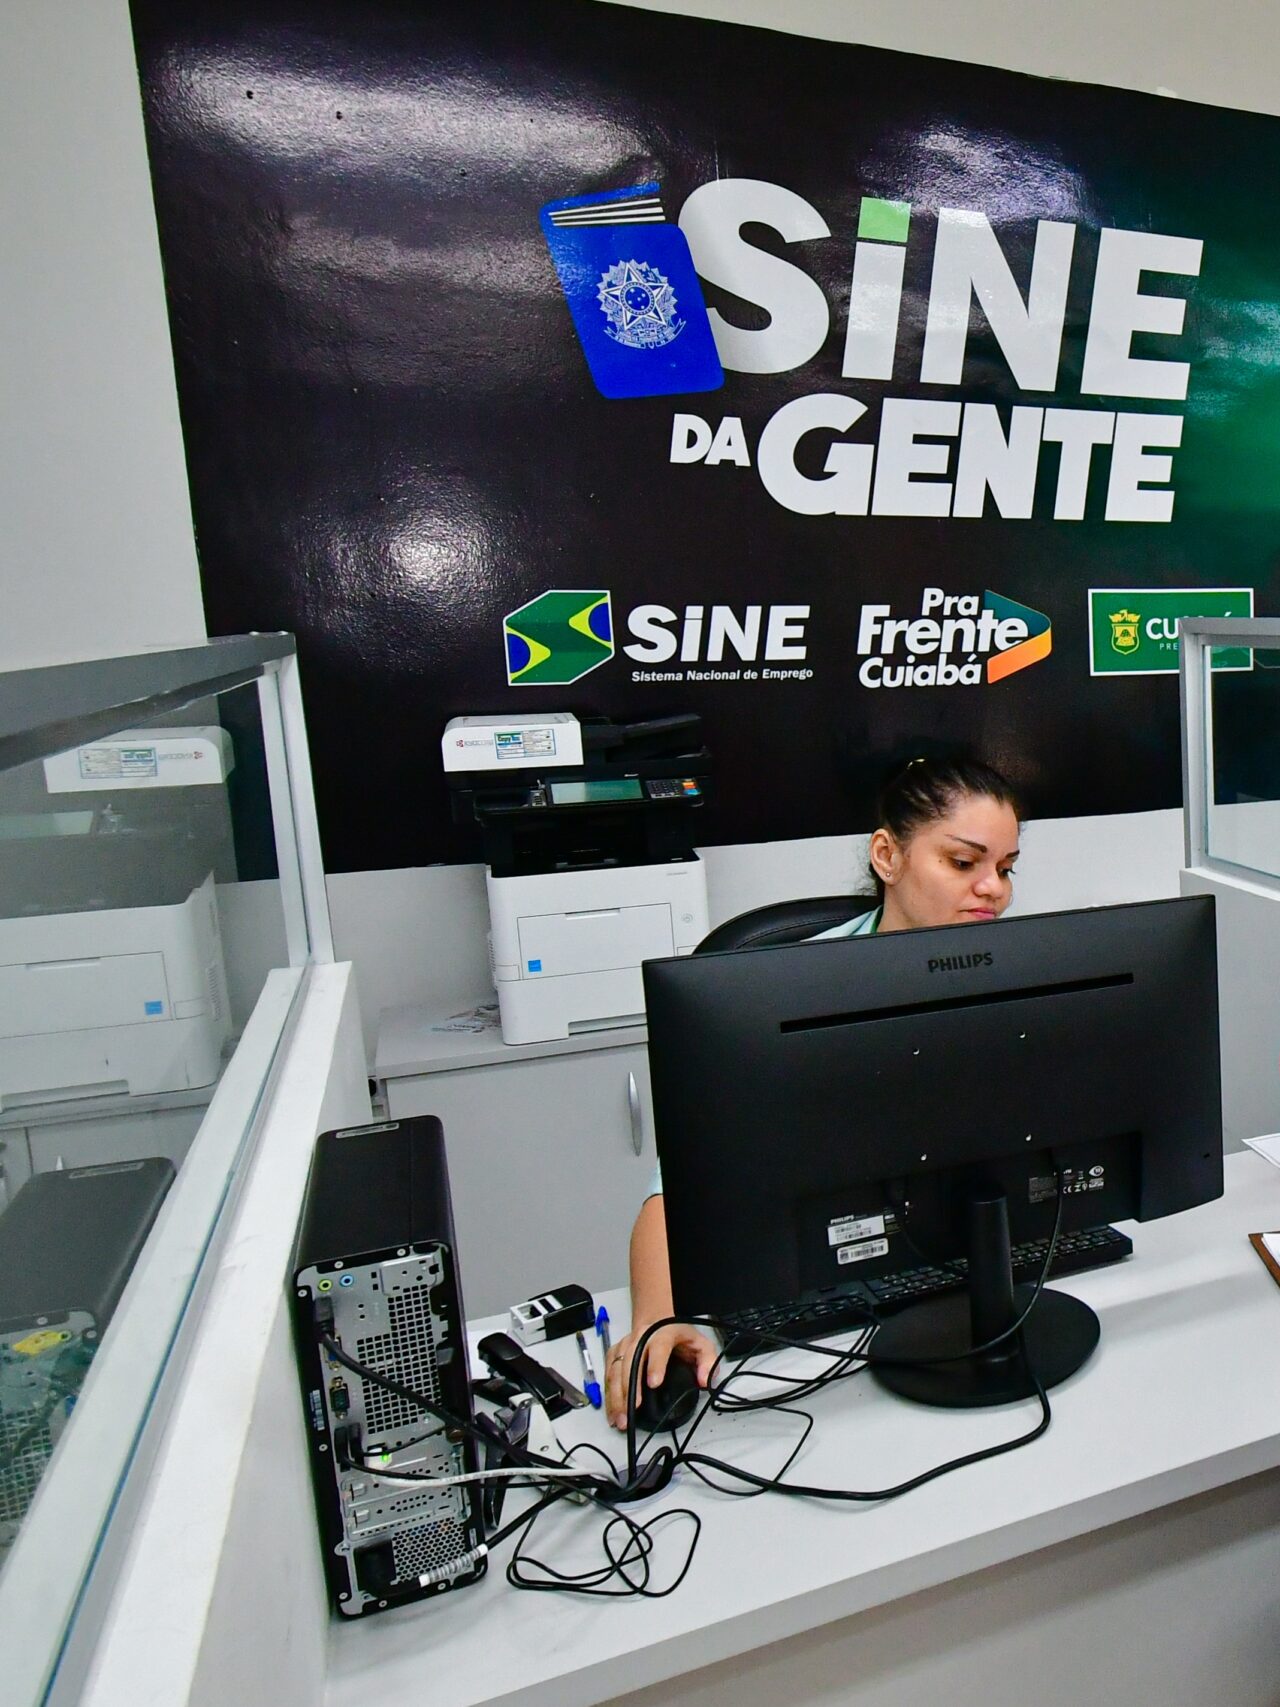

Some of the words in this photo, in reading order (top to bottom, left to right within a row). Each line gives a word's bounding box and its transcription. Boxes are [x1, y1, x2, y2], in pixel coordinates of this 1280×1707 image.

[678, 178, 1203, 400] SiNE
[669, 413, 750, 467] DA
[757, 393, 1184, 522] GENTE
[921, 588, 979, 616] Pra
[857, 605, 1029, 655] Frente
[631, 671, 683, 683] Sistema
[687, 669, 740, 681] Nacional
[743, 669, 758, 680] de
[762, 668, 814, 681] Emprego
[858, 653, 982, 689] Cuiabá
[927, 952, 994, 974] PHILIPS
